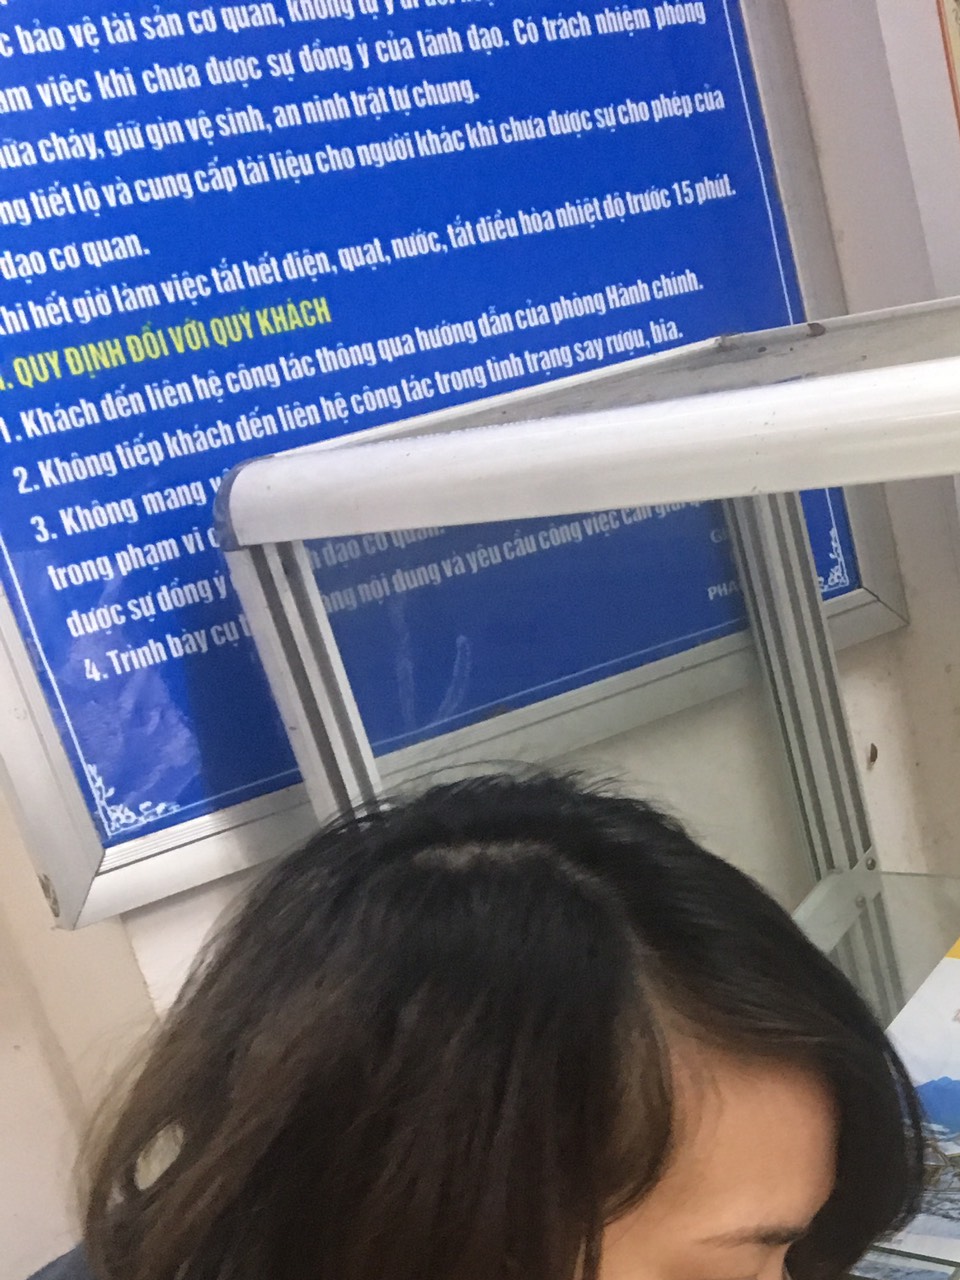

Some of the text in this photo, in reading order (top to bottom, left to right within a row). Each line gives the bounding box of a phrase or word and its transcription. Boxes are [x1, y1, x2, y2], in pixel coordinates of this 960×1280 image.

[30, 180, 75, 219] tiết
[73, 180, 101, 216] lộ
[103, 176, 134, 209] và
[134, 172, 193, 202] cung
[195, 156, 235, 192] cấp
[237, 153, 270, 186] tài
[271, 150, 314, 184] liệu
[315, 145, 356, 174] cho
[357, 132, 414, 168] người
[414, 125, 465, 157] khác
[466, 120, 498, 149] khi
[499, 116, 546, 144] chưa
[595, 106, 617, 132] sự
[617, 99, 650, 125] cho
[650, 91, 693, 123] phép
[694, 84, 726, 112] của
[29, 291, 73, 327] hết
[73, 285, 112, 323] giờ
[112, 283, 161, 312] làm
[162, 271, 212, 305] việc
[212, 258, 244, 293] tắt
[245, 251, 283, 286] hết
[448, 215, 476, 249] tắt
[520, 207, 554, 235] hòa
[556, 197, 603, 228] nhiệt
[626, 185, 672, 216] trước
[673, 180, 694, 206] 15
[13, 351, 63, 388] QUY
[65, 340, 126, 378] ĐỊNH
[127, 322, 169, 363] ĐỐI
[254, 296, 332, 336] KHÁCH
[20, 399, 100, 439] Khách
[146, 379, 192, 411] liên
[192, 370, 224, 403] hệ
[225, 364, 280, 394] công
[280, 352, 316, 381] tác
[316, 342, 376, 373] thông
[376, 335, 415, 364] qua
[415, 322, 478, 351] hướng
[478, 305, 514, 340] dẫn
[515, 299, 551, 331] của
[551, 291, 606, 326] phòng
[605, 281, 651, 309] Hành
